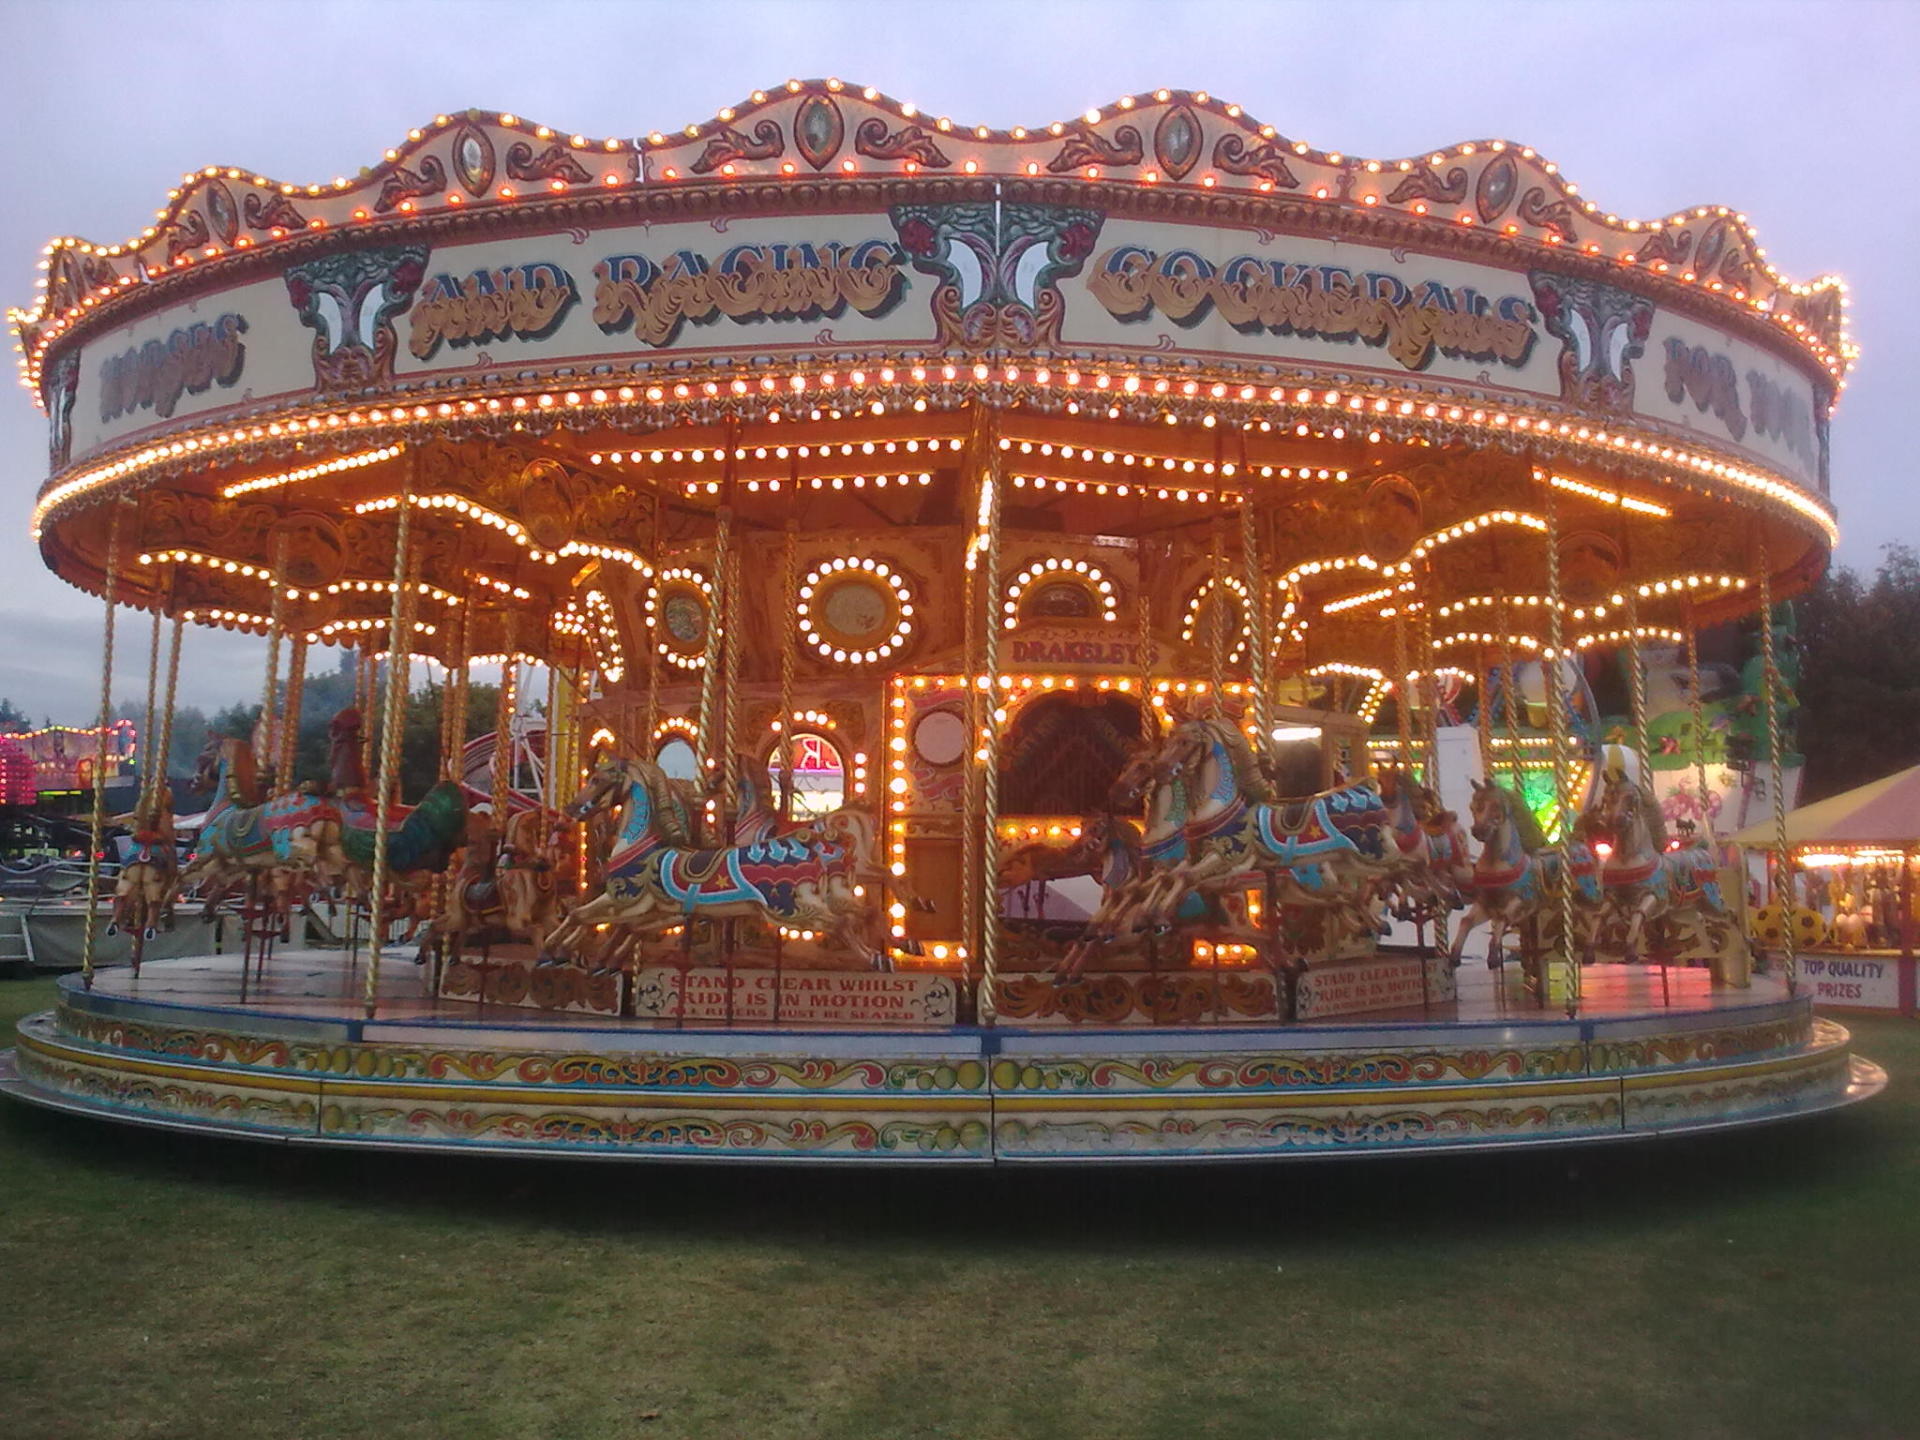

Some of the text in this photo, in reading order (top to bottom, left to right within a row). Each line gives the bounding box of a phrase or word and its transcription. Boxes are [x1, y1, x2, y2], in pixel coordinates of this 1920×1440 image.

[409, 240, 912, 362] AND RACING
[1086, 244, 1538, 370] COCKERALS
[1804, 960, 1884, 979] TOP QUALITY
[671, 976, 918, 992] STAND CLEAR WHILST
[1314, 971, 1355, 987] STAND
[1817, 982, 1862, 999] PRIZES
[682, 991, 904, 1008] RIDE IS IN MOTION
